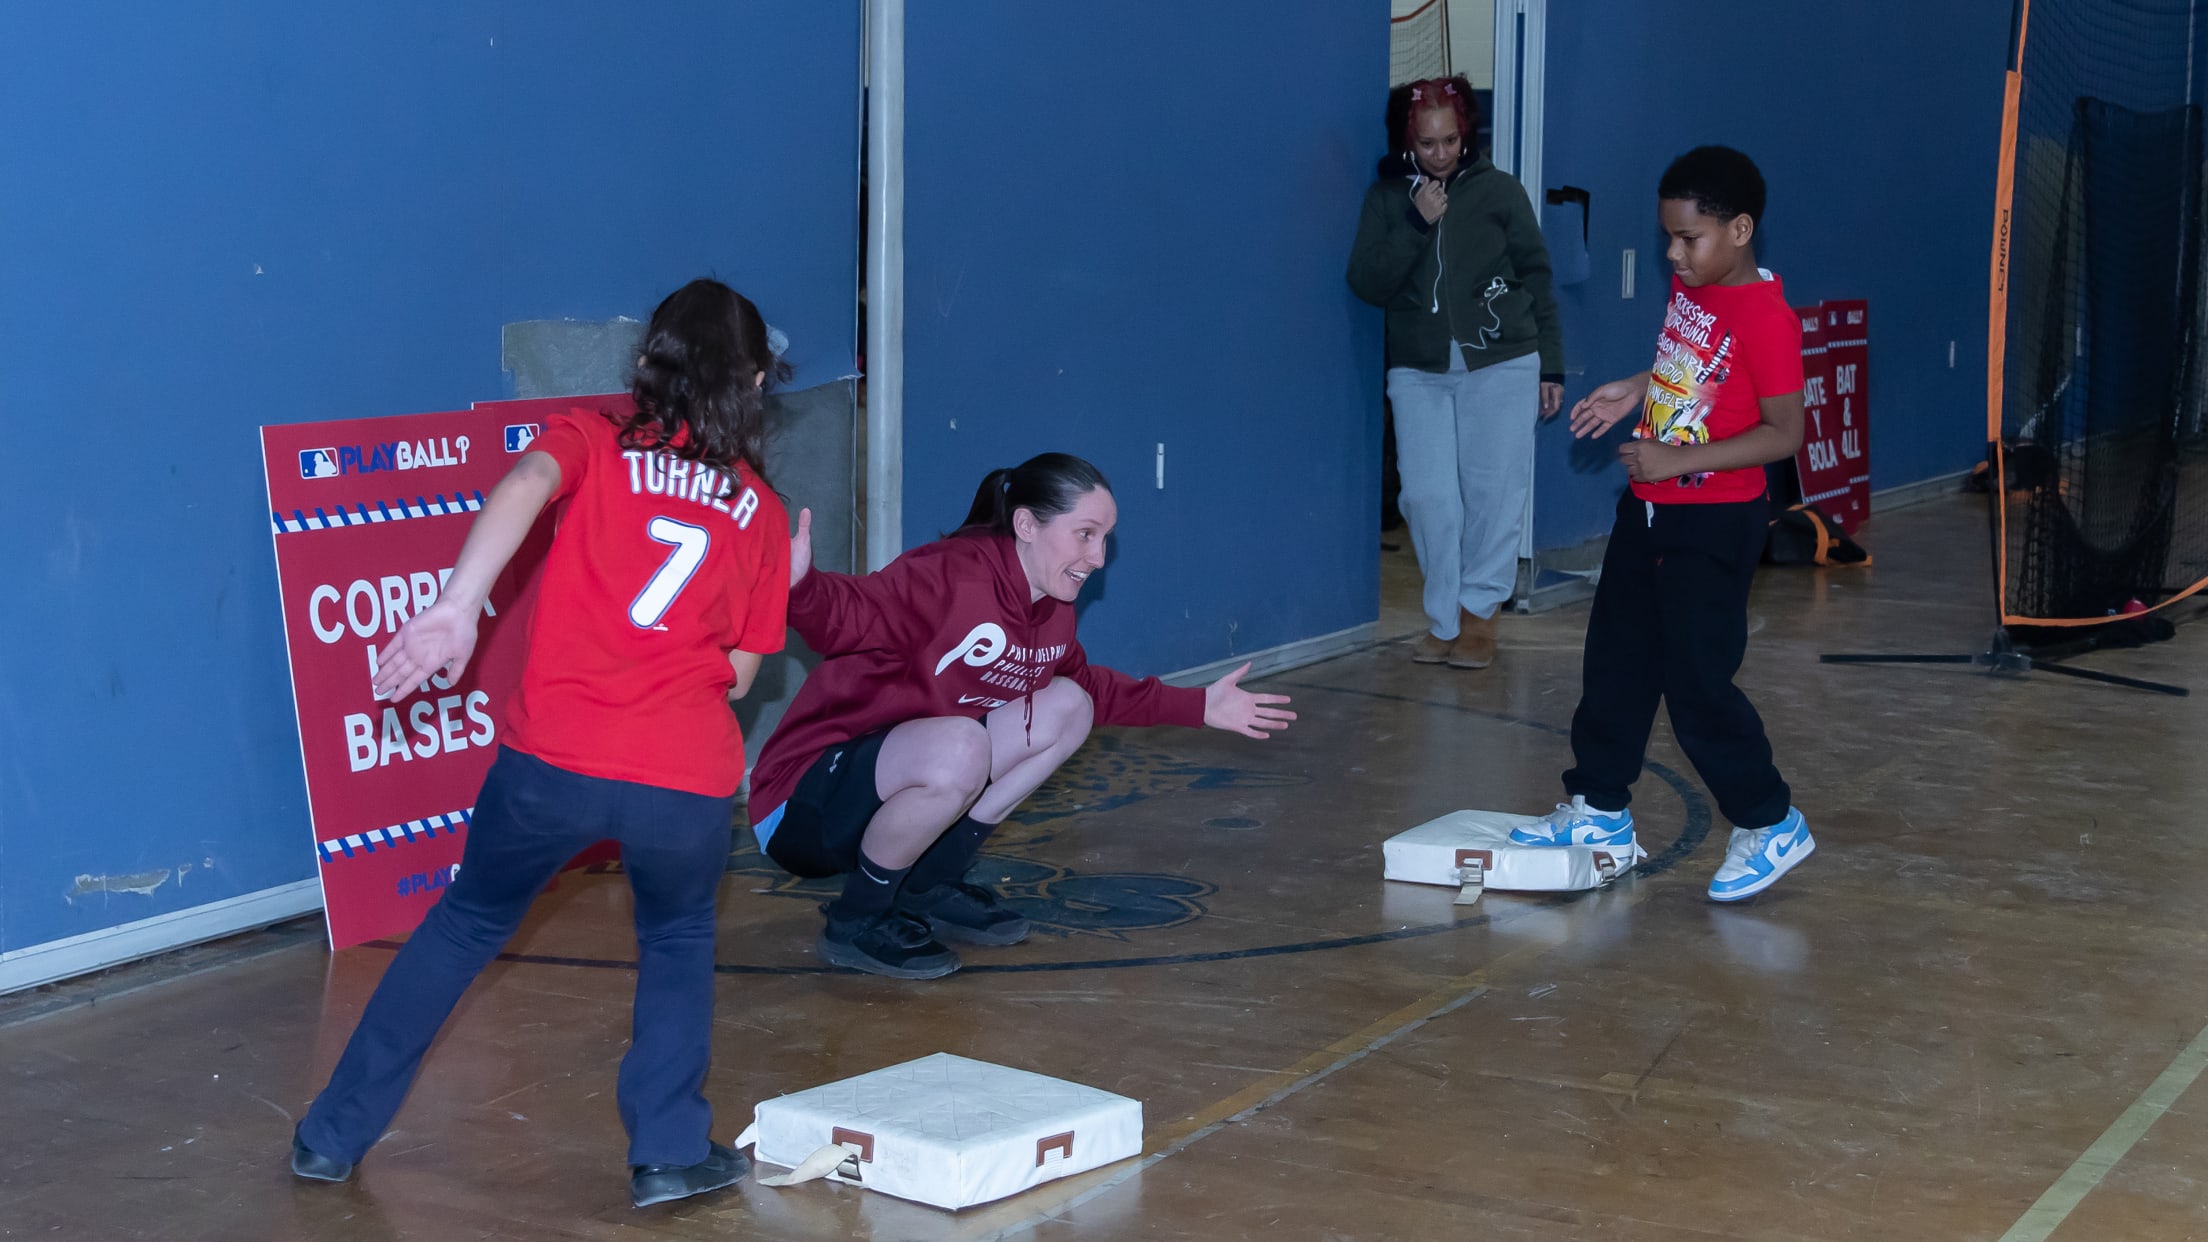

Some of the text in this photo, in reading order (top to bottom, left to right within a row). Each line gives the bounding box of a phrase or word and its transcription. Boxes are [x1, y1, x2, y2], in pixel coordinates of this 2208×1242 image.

[1665, 312, 1711, 348] ORIGINAL
[1836, 364, 1857, 395] BAT
[1812, 409, 1822, 438] Y
[1843, 397, 1852, 427] &
[1807, 438, 1839, 472] BOLA
[622, 450, 759, 530] TURNER
[628, 515, 711, 630] 7
[344, 690, 496, 772] BASES
